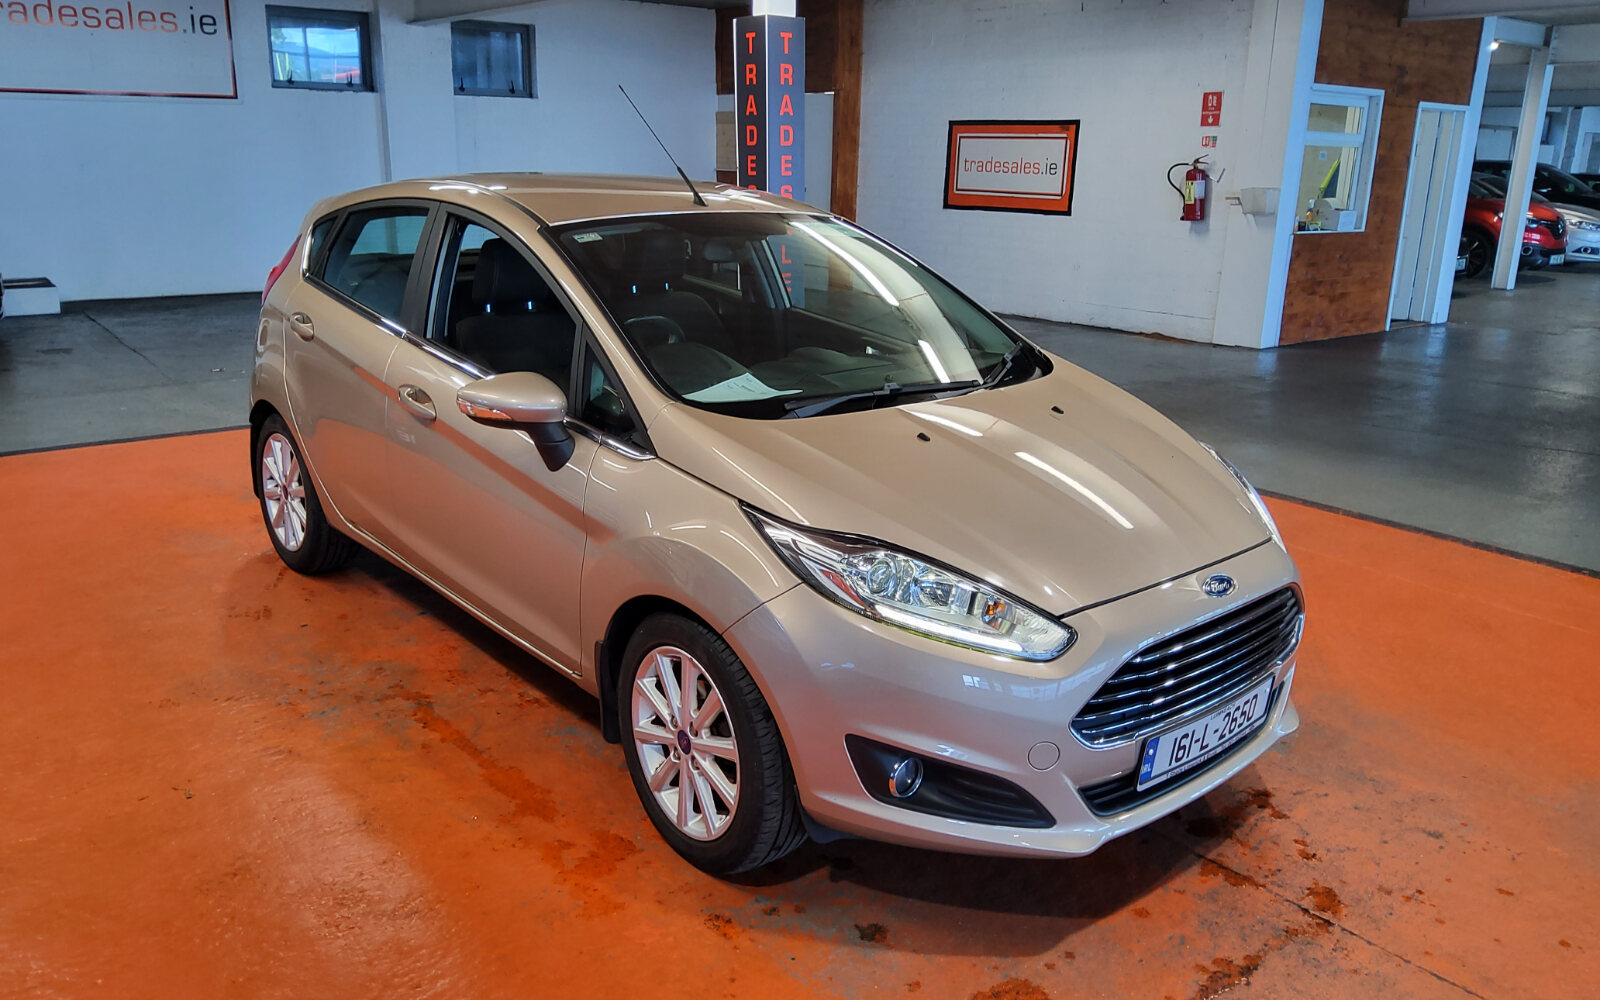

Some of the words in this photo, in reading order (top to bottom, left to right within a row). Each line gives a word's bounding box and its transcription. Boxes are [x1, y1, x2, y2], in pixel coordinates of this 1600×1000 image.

[0, 0, 218, 36] adesales.ie
[745, 31, 758, 191] TRADE
[963, 155, 1058, 176] tradesales.ie
[1168, 693, 1259, 767] 161-L-2650
